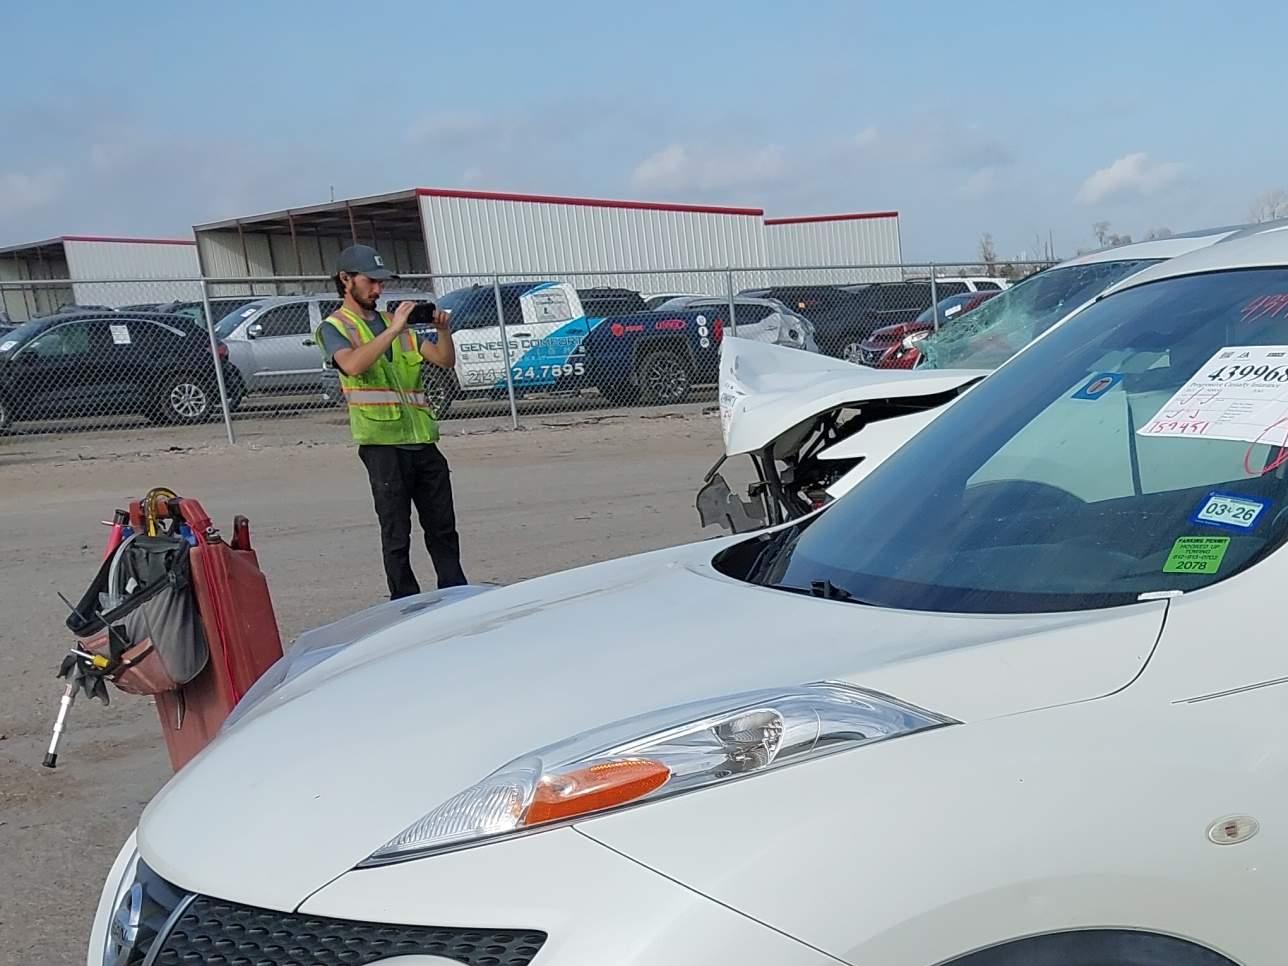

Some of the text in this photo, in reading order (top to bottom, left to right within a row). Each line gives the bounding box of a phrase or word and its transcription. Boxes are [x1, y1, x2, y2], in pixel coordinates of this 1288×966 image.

[460, 340, 519, 352] GENESS
[1206, 502, 1256, 521] 03 26
[1175, 561, 1208, 570] 2078
